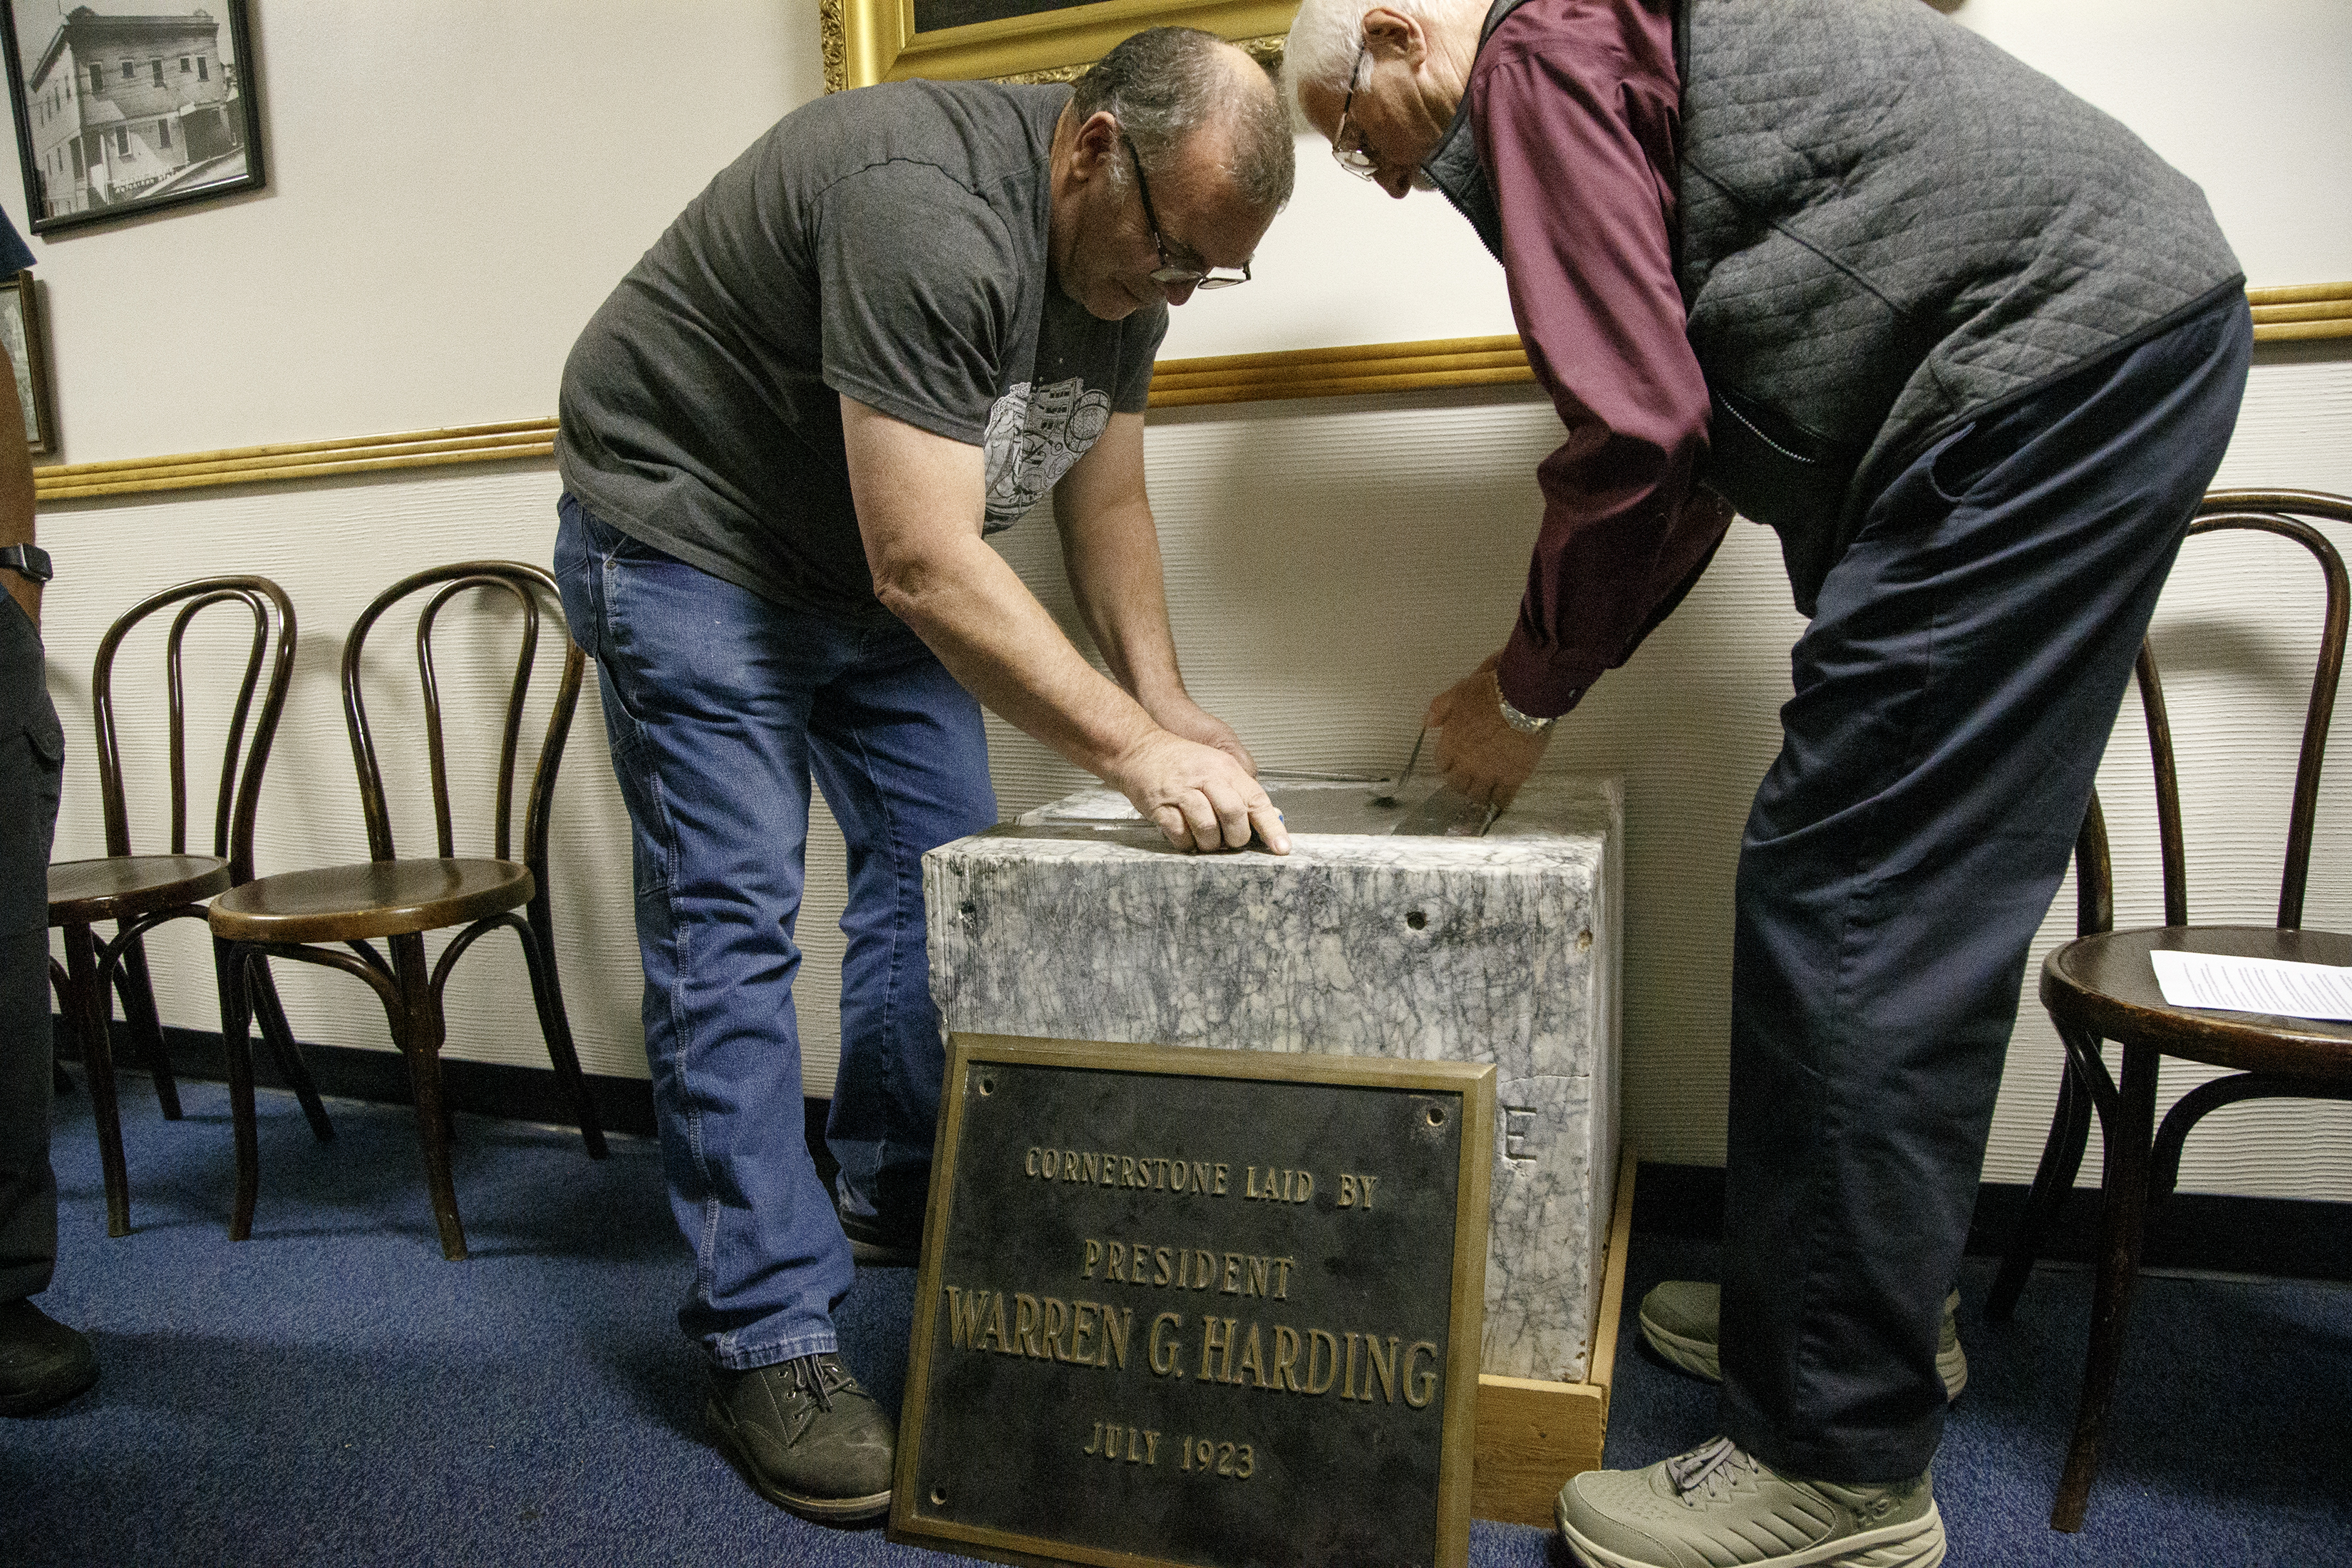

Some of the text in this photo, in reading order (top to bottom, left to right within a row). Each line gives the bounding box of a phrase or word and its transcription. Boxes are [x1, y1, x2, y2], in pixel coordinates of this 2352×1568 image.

[1025, 1147, 1377, 1208] CORNERSTONE LAID BY
[1080, 1238, 1296, 1300] PRESIDENT
[944, 1286, 1438, 1408] WARREN G. HARDING
[1083, 1423, 1254, 1478] JULY 1923
